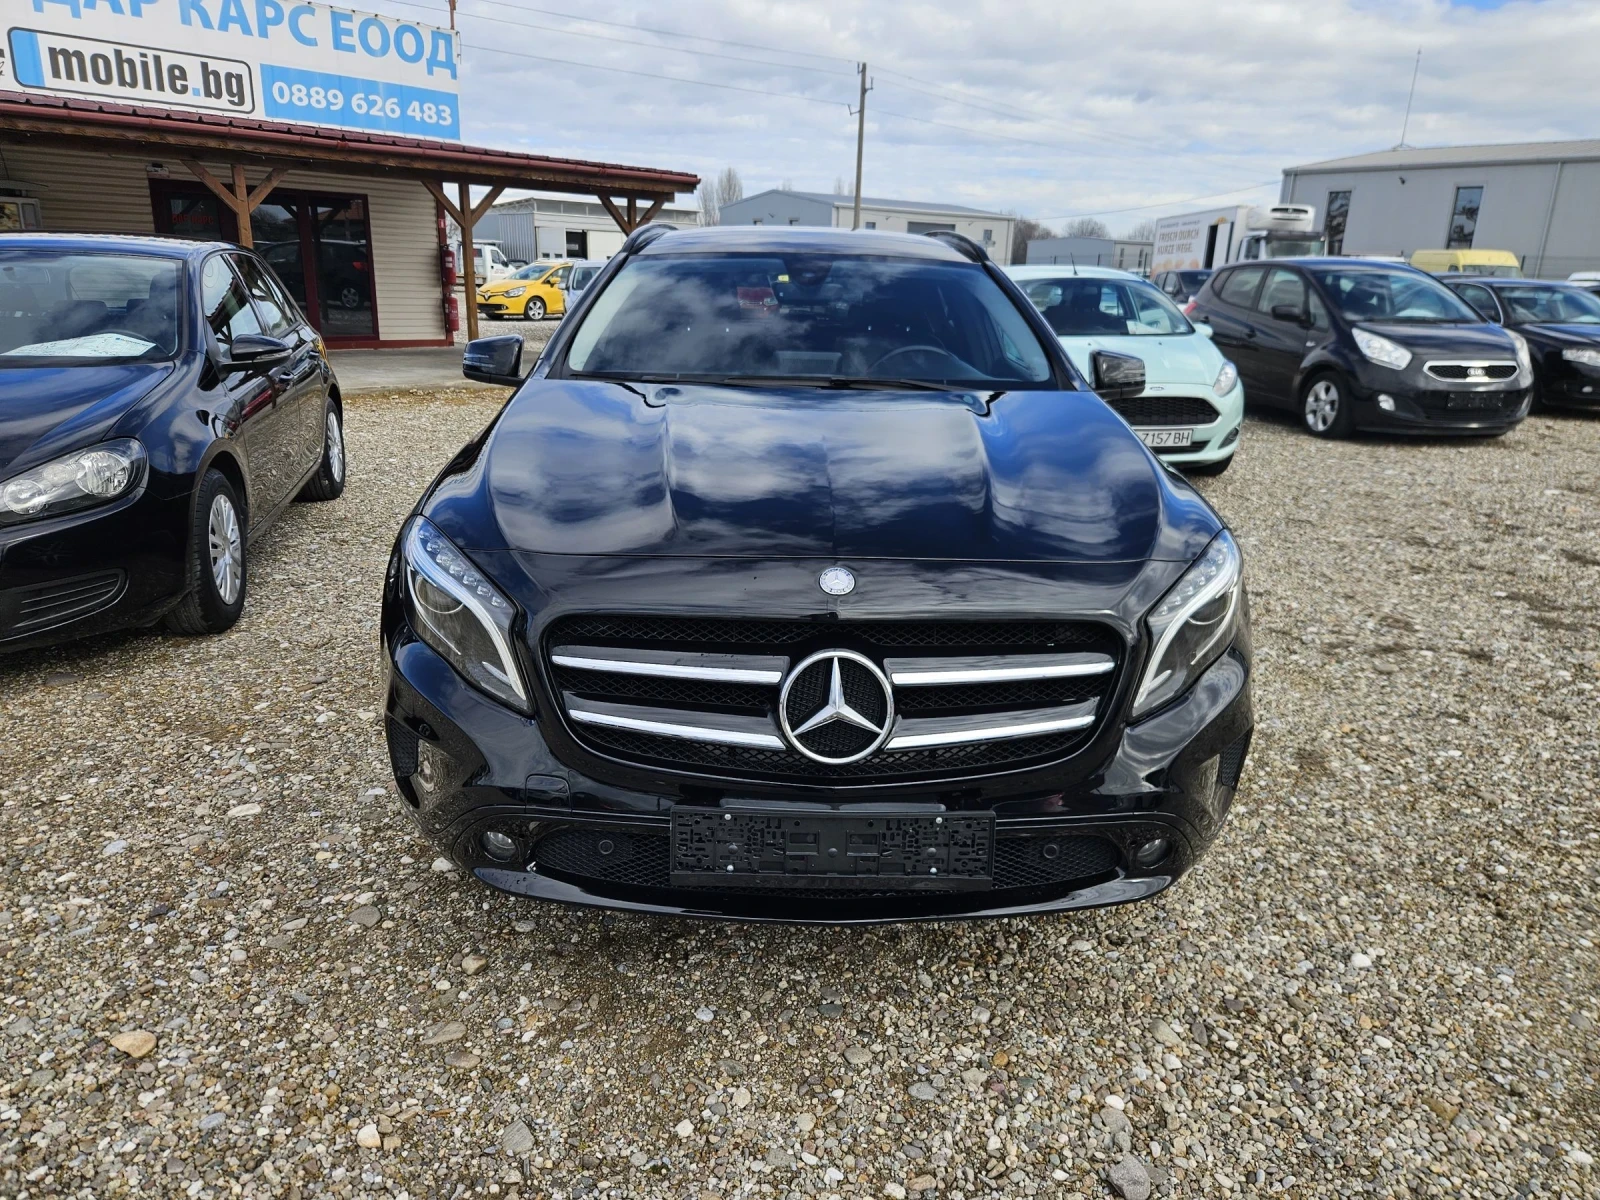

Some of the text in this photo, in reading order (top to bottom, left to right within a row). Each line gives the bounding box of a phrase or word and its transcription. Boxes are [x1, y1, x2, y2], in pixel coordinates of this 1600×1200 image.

[179, 0, 458, 81] КАРС ЕООД
[47, 46, 246, 107] mobile.bg
[272, 81, 453, 126] 0889 626 483
[1159, 227, 1200, 243] FRISCH DURCH
